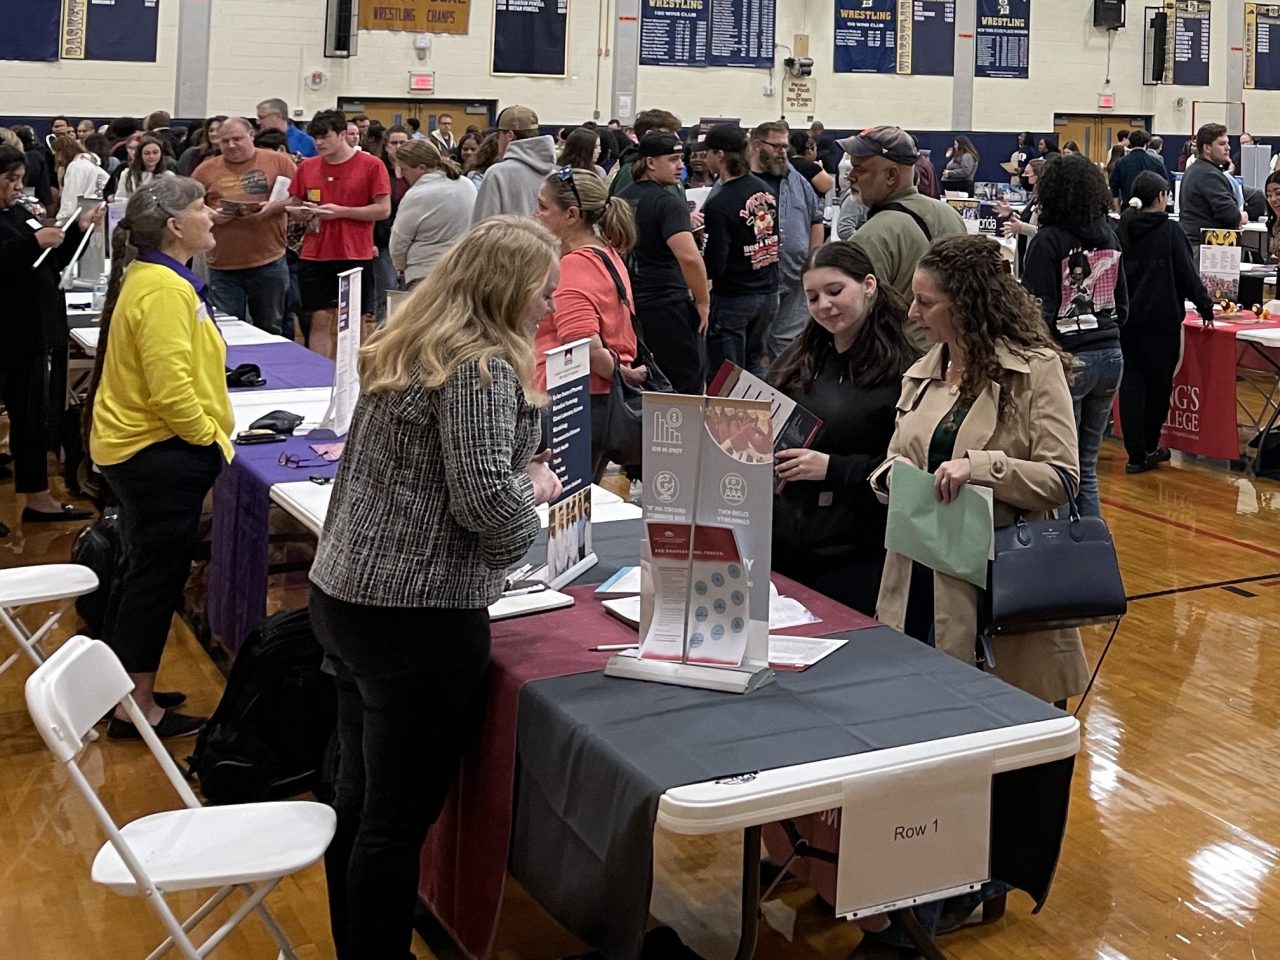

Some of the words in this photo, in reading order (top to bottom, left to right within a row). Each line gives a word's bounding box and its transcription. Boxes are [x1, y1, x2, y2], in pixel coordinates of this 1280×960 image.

[373, 6, 416, 22] WRESTLING
[426, 8, 456, 24] CHAMPS
[840, 9, 892, 20] WRESTLING
[981, 16, 1025, 27] WRESTLING
[894, 824, 927, 841] Row
[932, 818, 938, 833] 1
